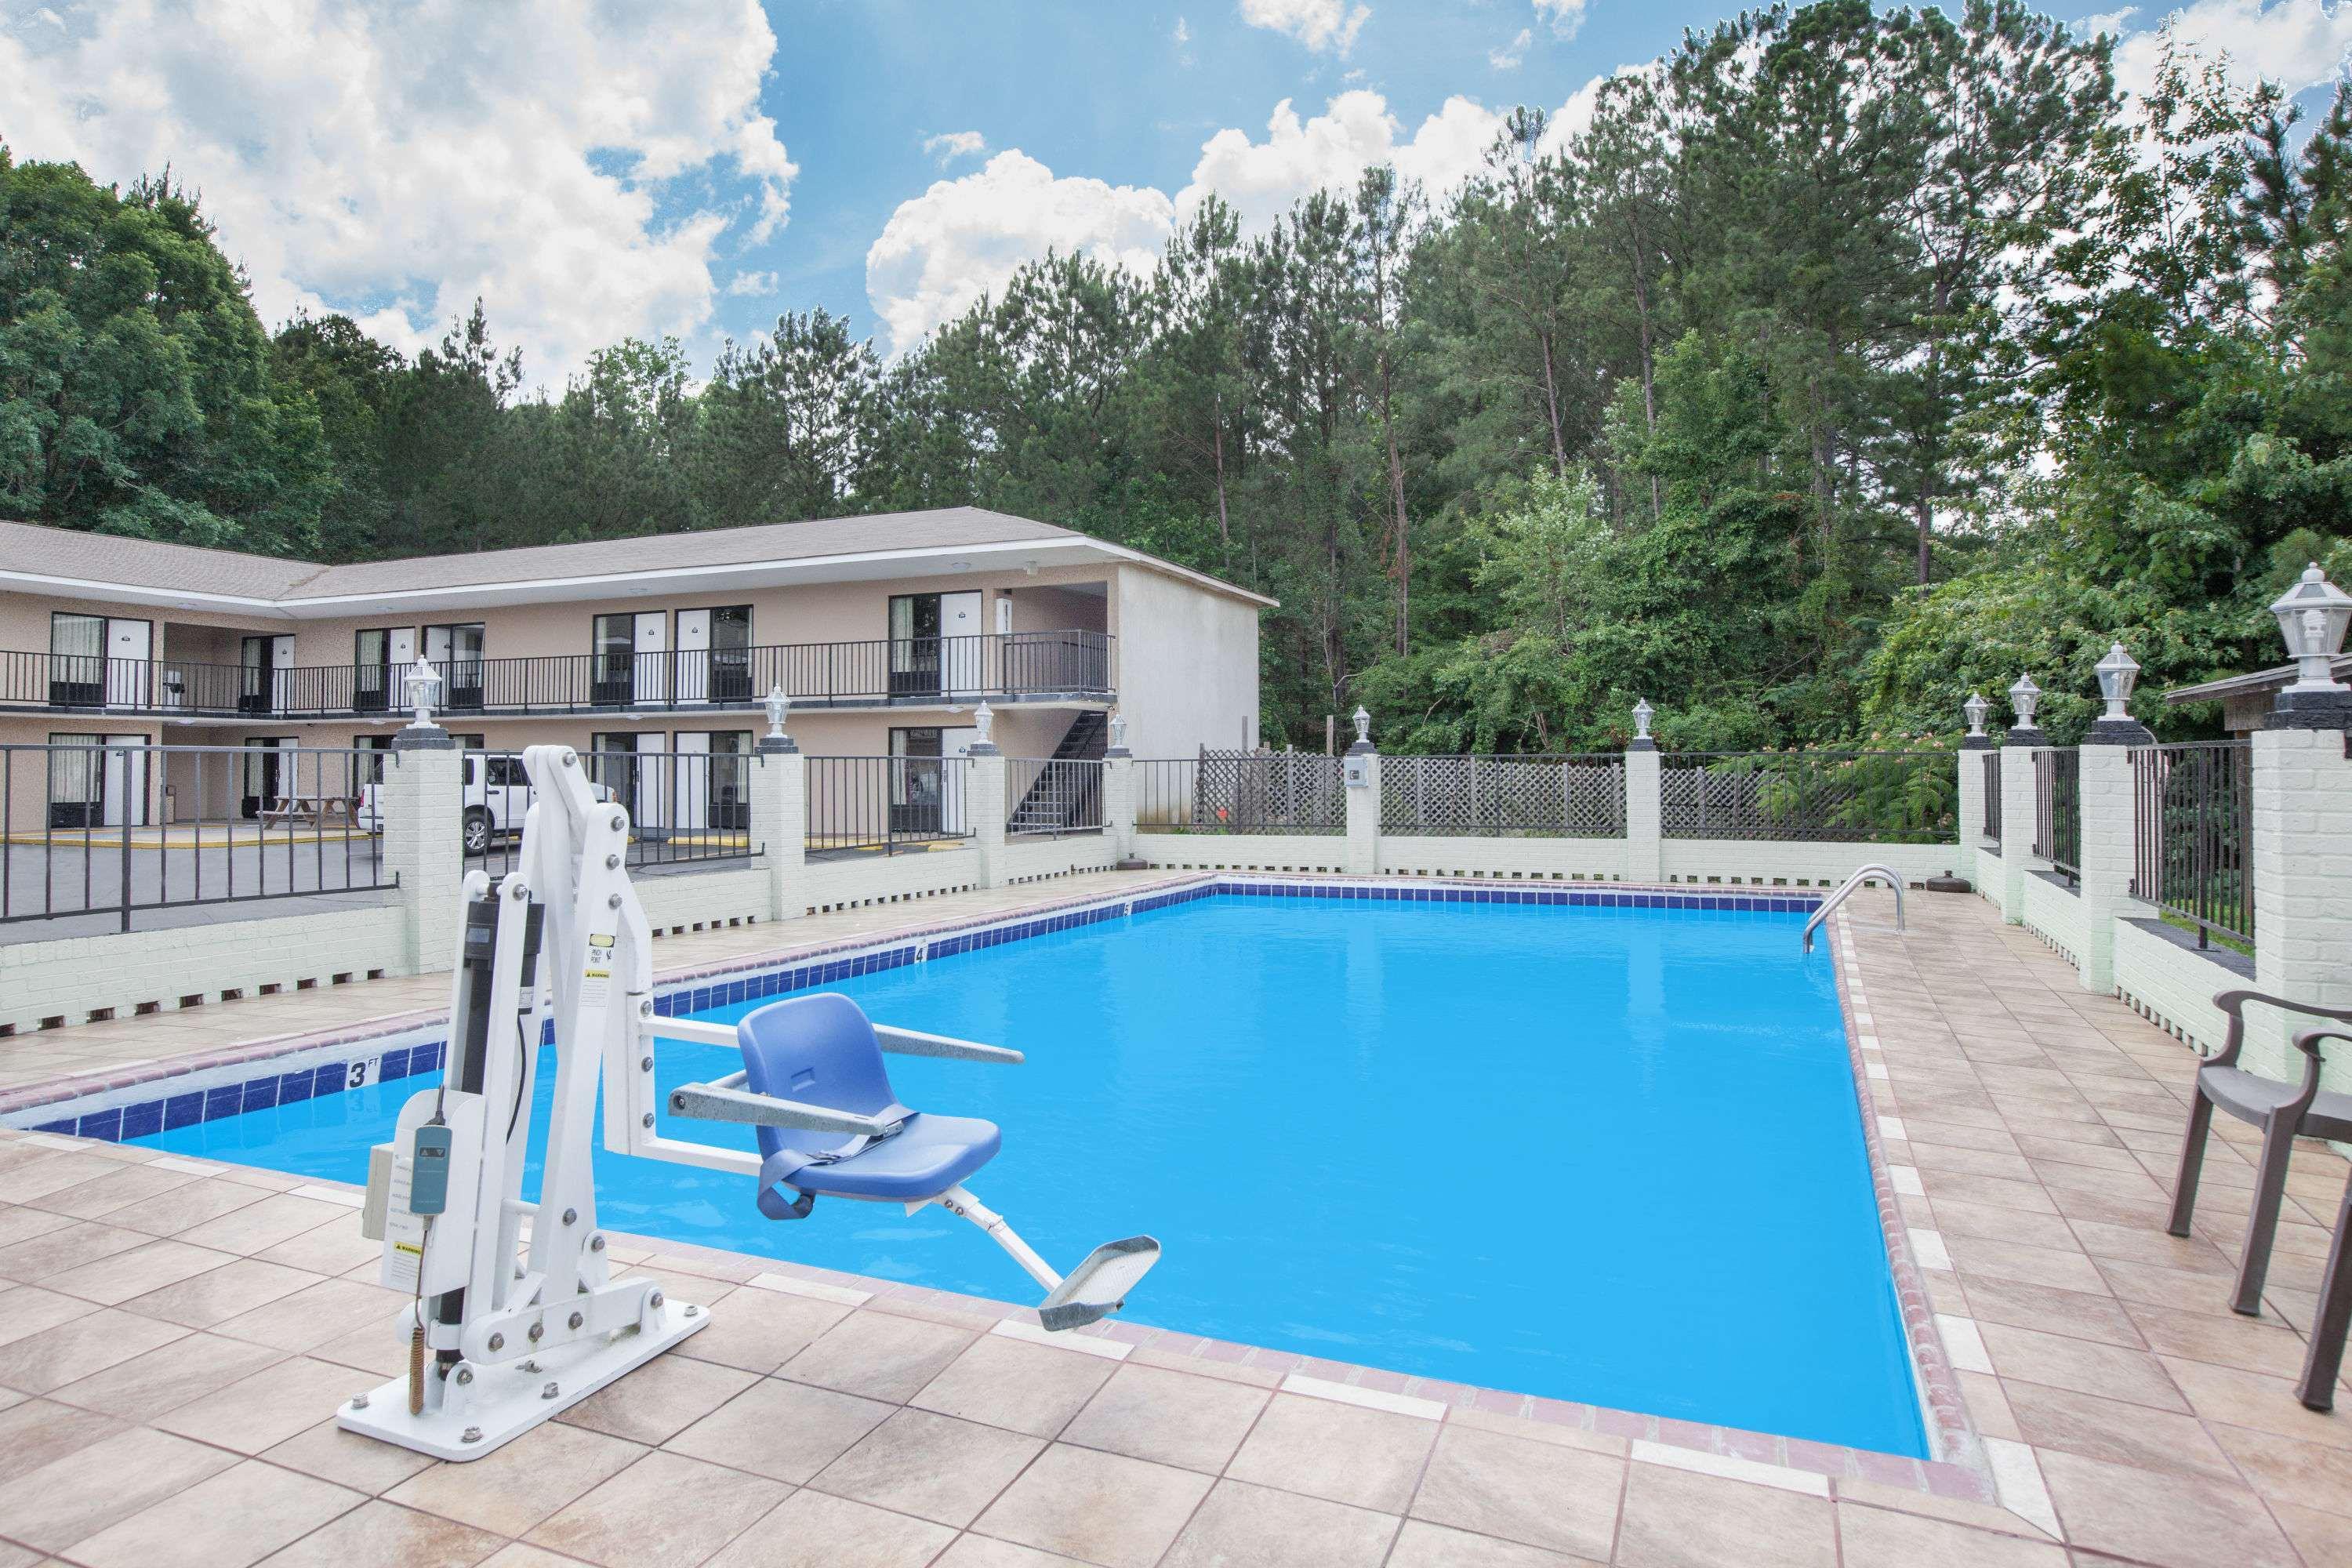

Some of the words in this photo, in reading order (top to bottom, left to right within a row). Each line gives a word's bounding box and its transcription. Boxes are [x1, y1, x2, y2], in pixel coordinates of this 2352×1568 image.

[1123, 904, 1130, 916] 5
[916, 947, 924, 963] 4
[349, 1062, 366, 1088] 3
[368, 1057, 379, 1068] FT
[401, 1246, 421, 1254] WARNING
